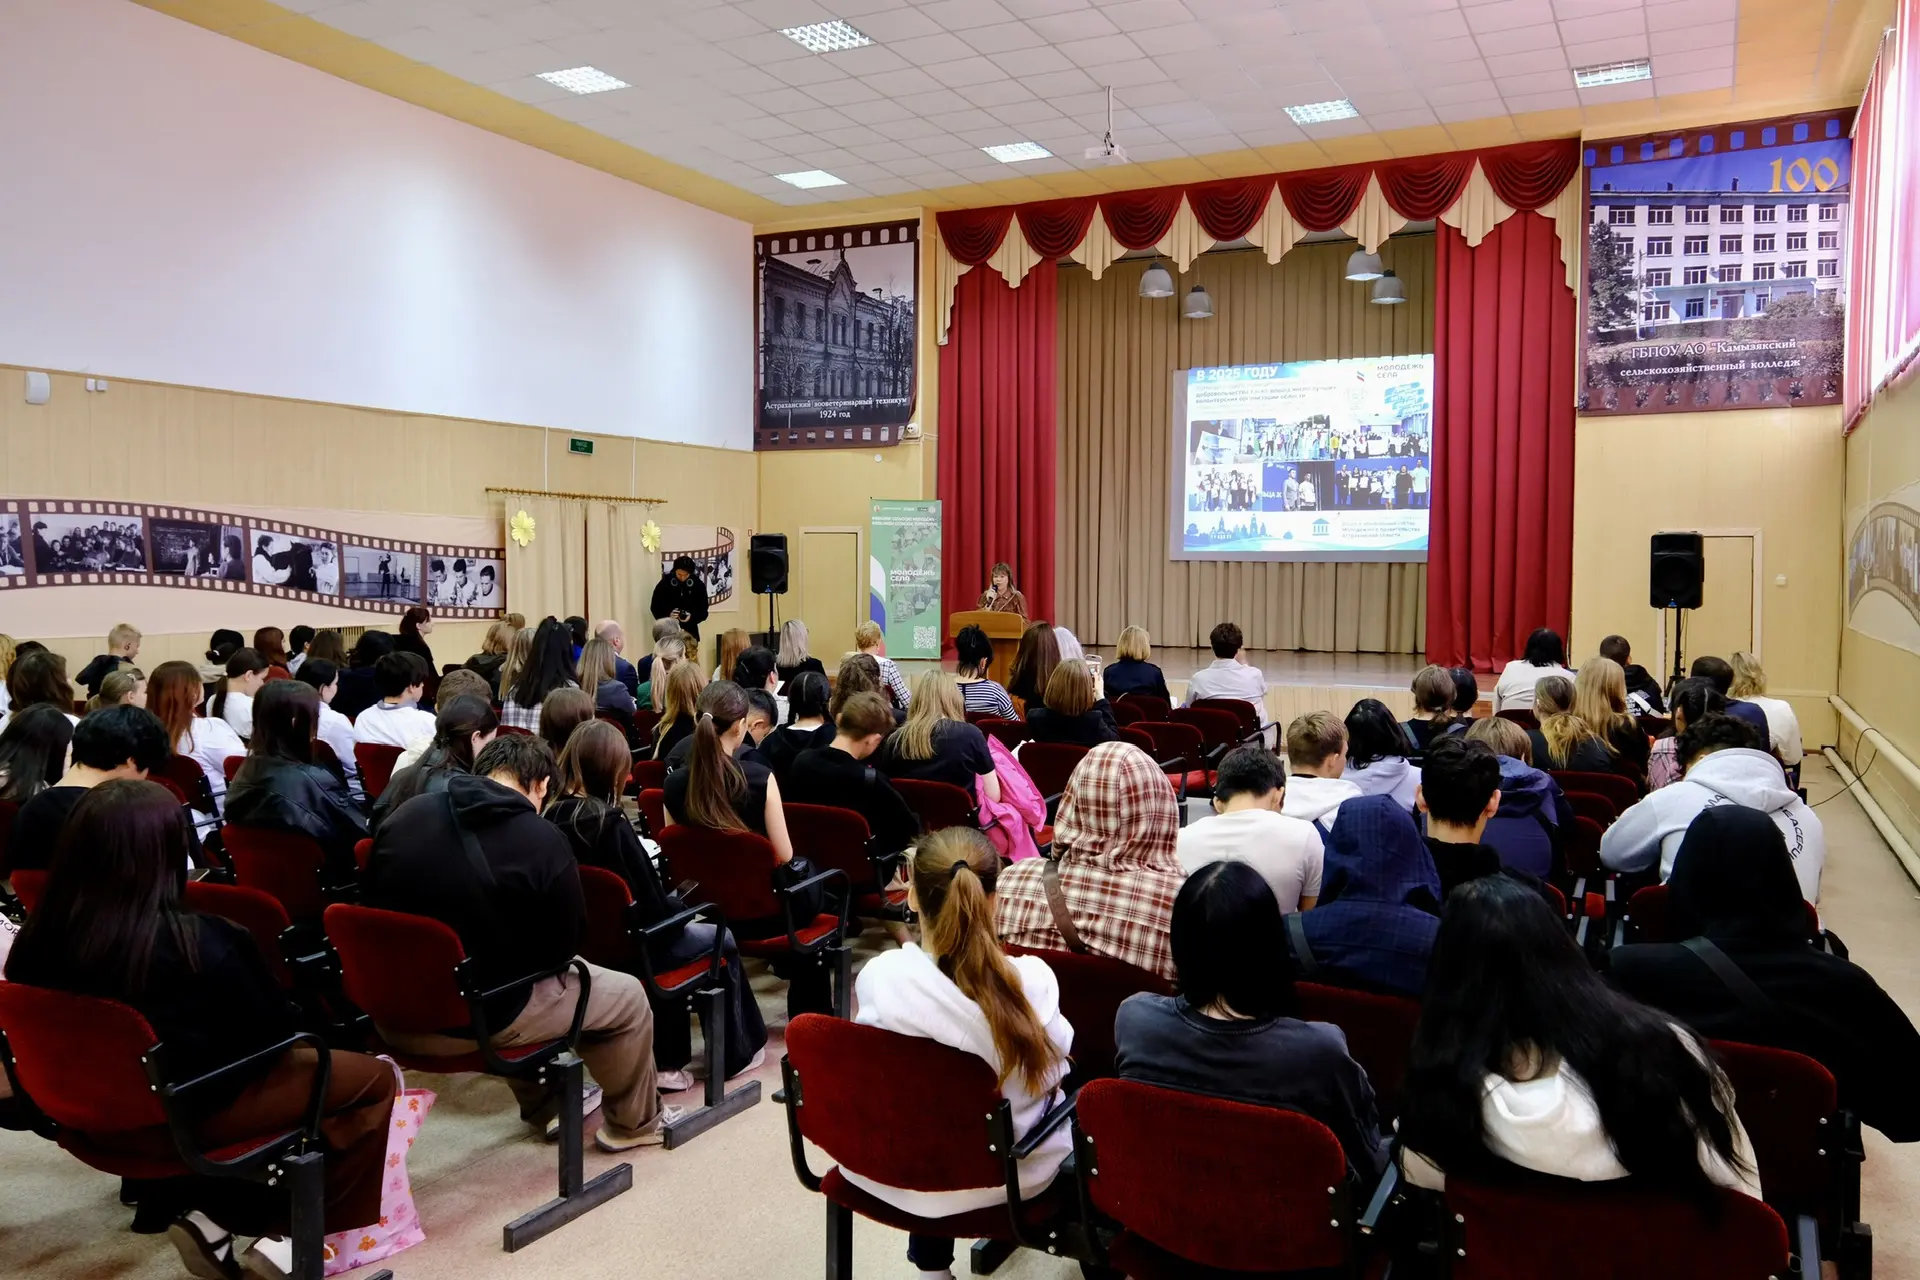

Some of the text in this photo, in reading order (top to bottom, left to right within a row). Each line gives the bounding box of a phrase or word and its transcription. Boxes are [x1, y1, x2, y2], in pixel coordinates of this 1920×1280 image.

[1769, 157, 1838, 192] 100
[1631, 338, 1797, 358] ГБПОУ АО "Камызякский
[1196, 366, 1279, 381] В 2025 ГОДУ
[1620, 355, 1807, 377] сельскохозяйственный колледж"
[1376, 372, 1399, 380] СЕЛА
[764, 396, 908, 411] Астраханский зооветеринарный техникум
[819, 409, 851, 419] 1924 год
[1779, 806, 1804, 860] EACEFU
